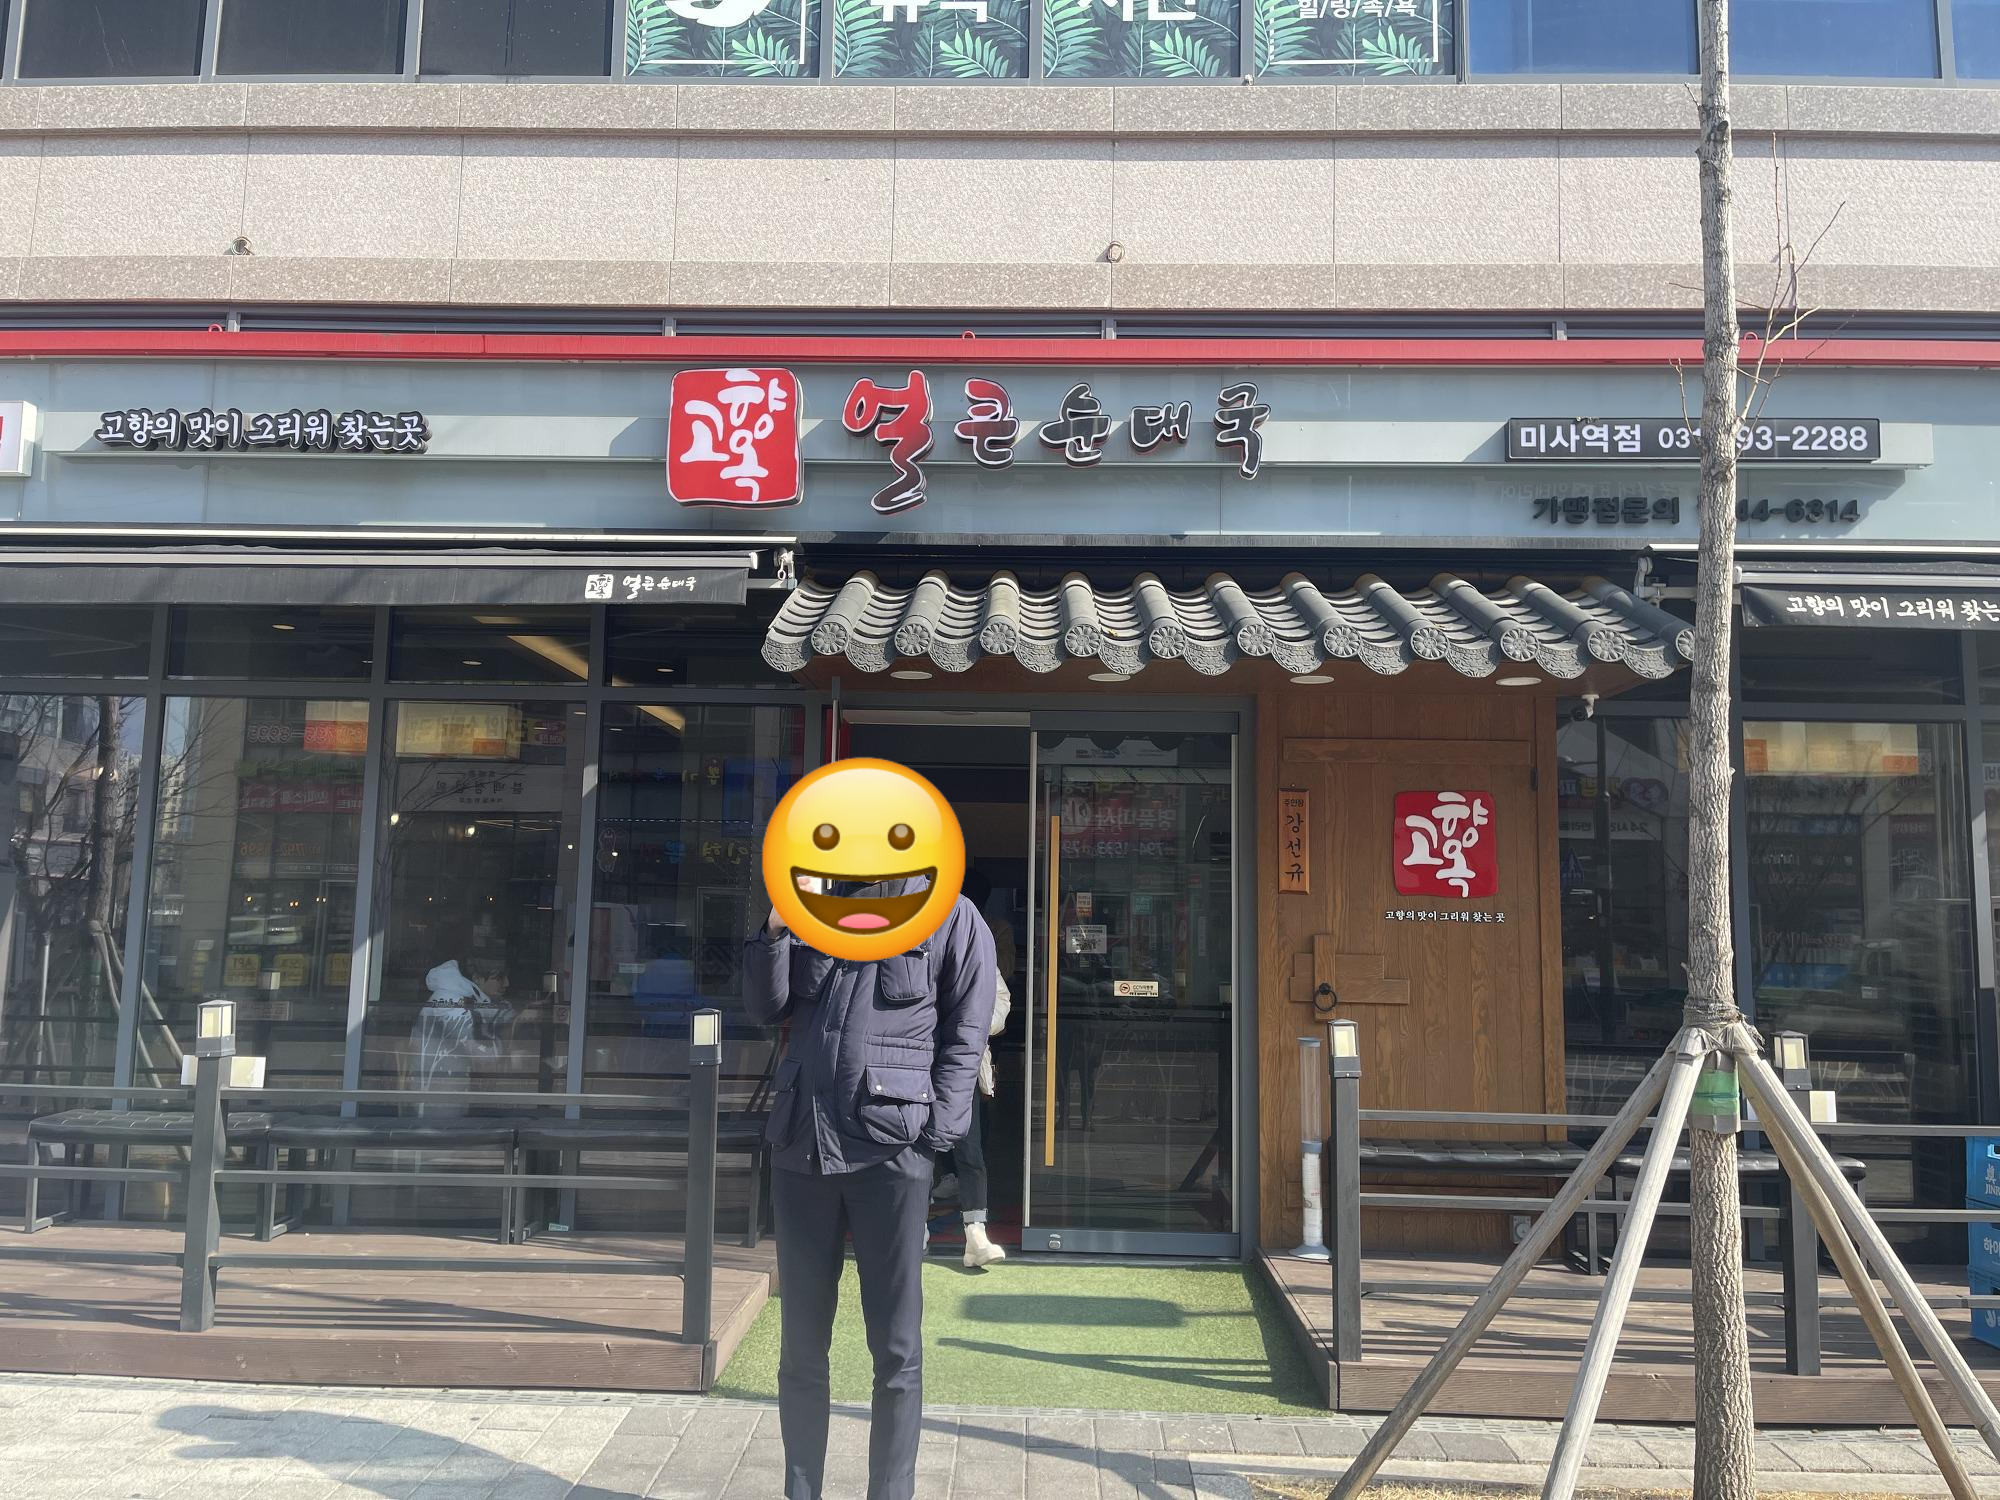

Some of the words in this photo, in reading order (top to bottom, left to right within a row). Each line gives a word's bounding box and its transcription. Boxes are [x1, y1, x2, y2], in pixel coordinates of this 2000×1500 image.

[97, 411, 179, 446] 고향의
[188, 411, 240, 446] 맛이
[248, 412, 330, 447] 그리워
[1519, 423, 1642, 453] 미사역점
[1786, 595, 1845, 617] 고향의
[1849, 596, 1889, 618] 맛이
[1896, 596, 1955, 620] 그리워
[1285, 812, 1305, 883] 강선규
[1402, 790, 1489, 898] 고향옥
[1385, 910, 1415, 921] 고향의
[1417, 910, 1437, 921] 맛이
[1439, 911, 1469, 922] 그리워
[1472, 911, 1493, 923] 찾는
